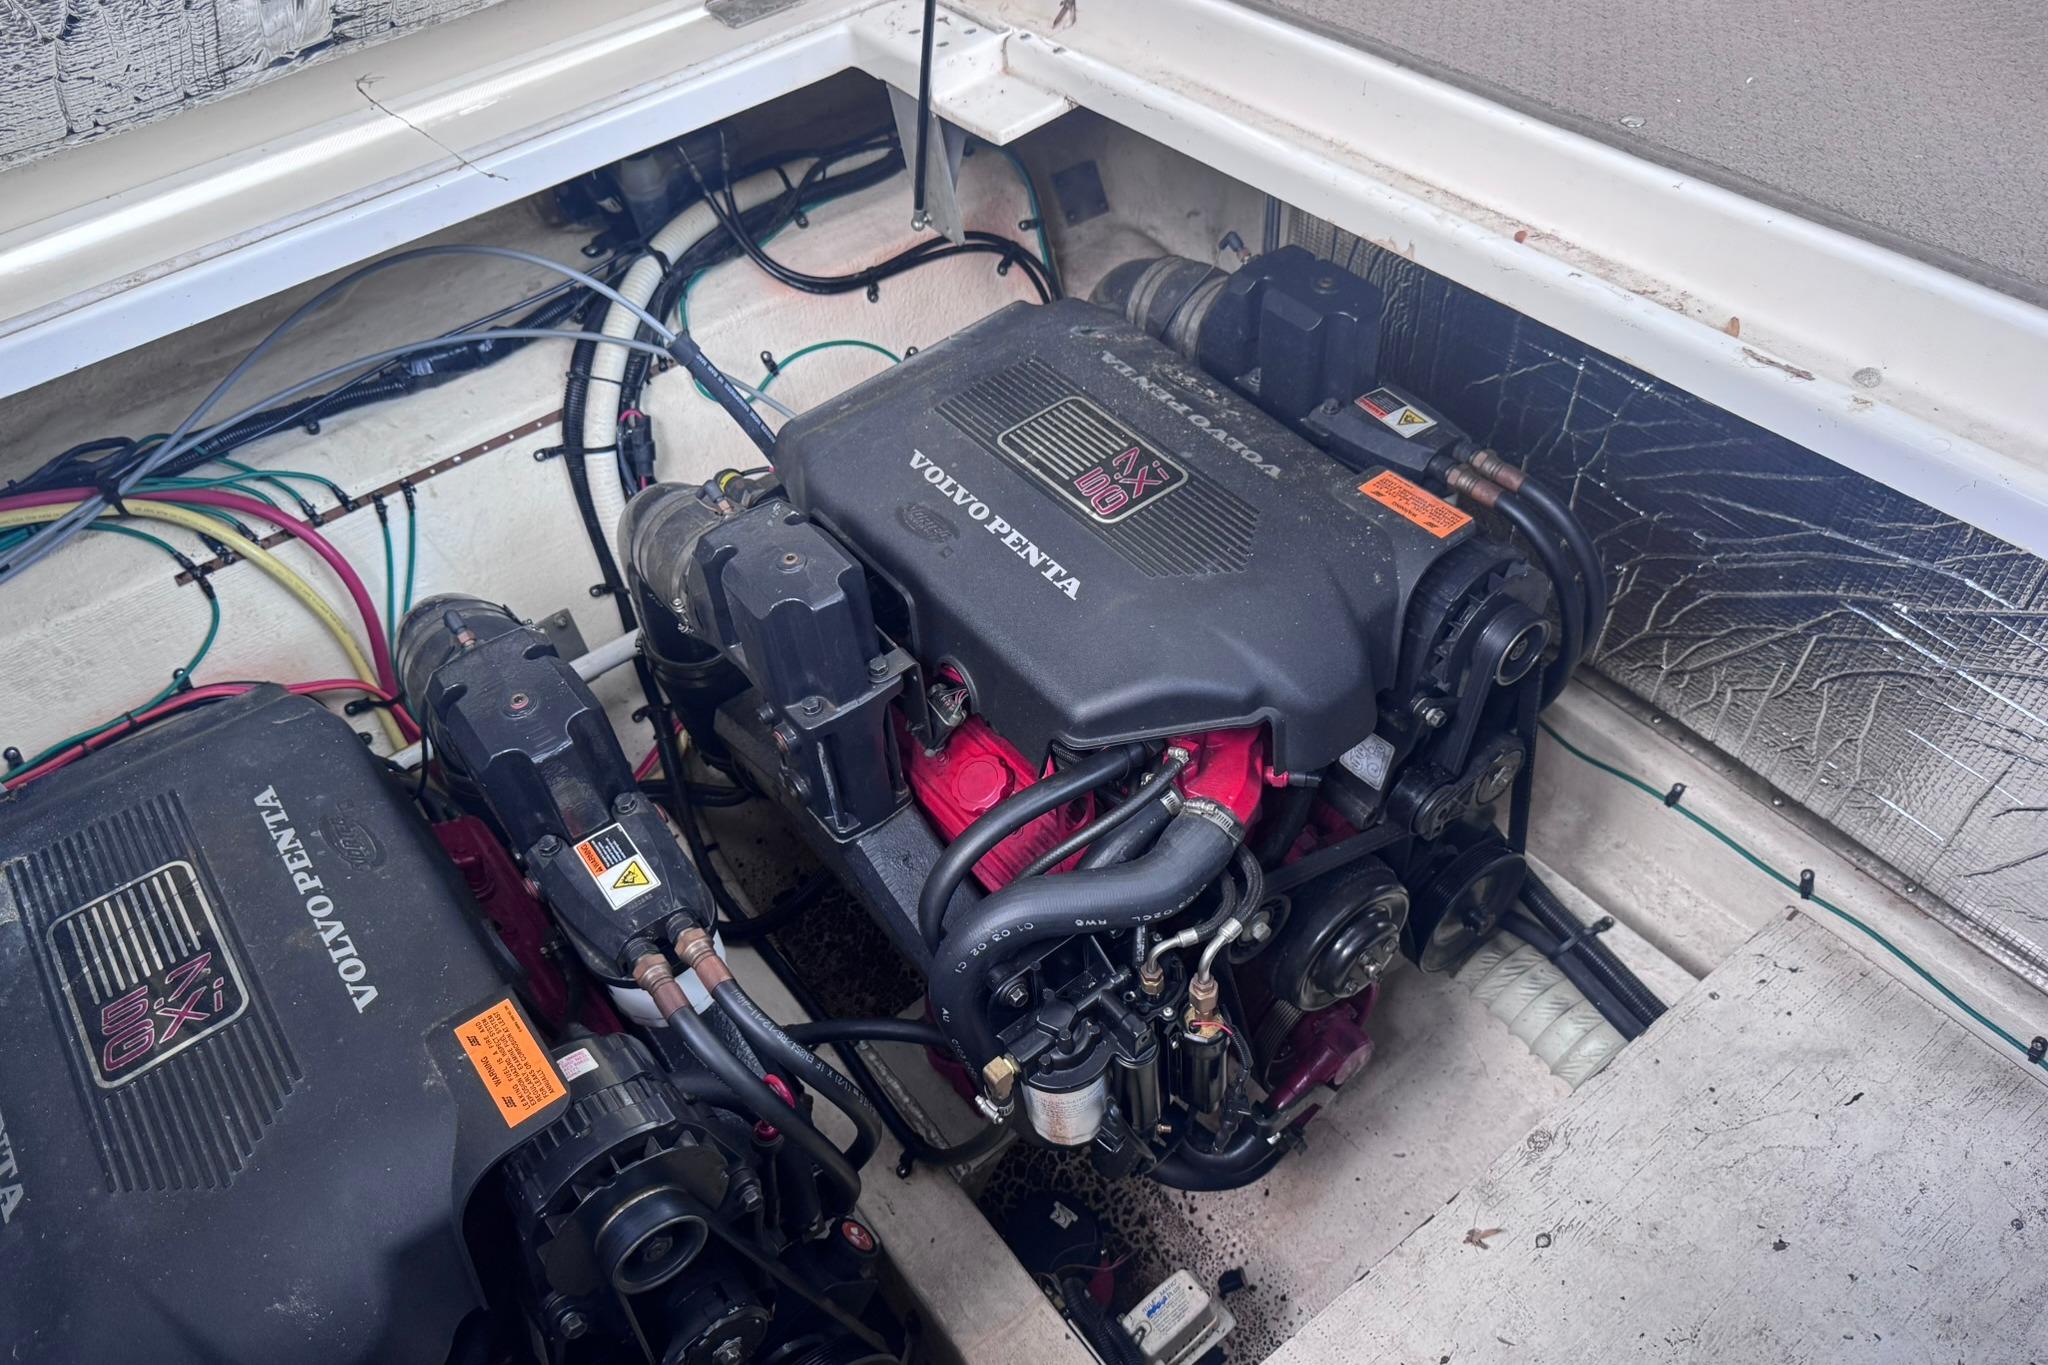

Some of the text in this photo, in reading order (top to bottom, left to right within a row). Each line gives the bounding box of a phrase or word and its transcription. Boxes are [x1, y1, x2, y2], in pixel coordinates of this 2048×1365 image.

[1102, 350, 1281, 479] VOLVO PENTA
[1073, 447, 1140, 496] 5.7
[909, 449, 990, 520] VOLVO
[984, 515, 1081, 600] PENTA
[254, 785, 324, 895] PENTA
[306, 895, 379, 1014] VOLVO
[101, 952, 212, 1036] 5.7
[103, 976, 224, 1071] GXi
[474, 1020, 485, 1034] AND
[480, 1017, 496, 1037] SYSTEM
[486, 1013, 502, 1034] SYSTEM
[492, 1010, 505, 1027] LEAST
[502, 1025, 509, 1033] AT
[482, 1034, 494, 1048] FIRE
[498, 1033, 510, 1048] FUEL
[505, 1032, 527, 1062] CORROSION
[506, 1047, 524, 1070] EXAMINE
[522, 1060, 532, 1070] OR
[479, 1055, 502, 1087] WARNING
[501, 1065, 514, 1081] FUEL
[527, 1068, 542, 1087] LEAKS
[511, 1083, 530, 1110] LEAKING
[515, 1077, 537, 1106] EXPLOSION
[538, 1086, 549, 1098] FOR
